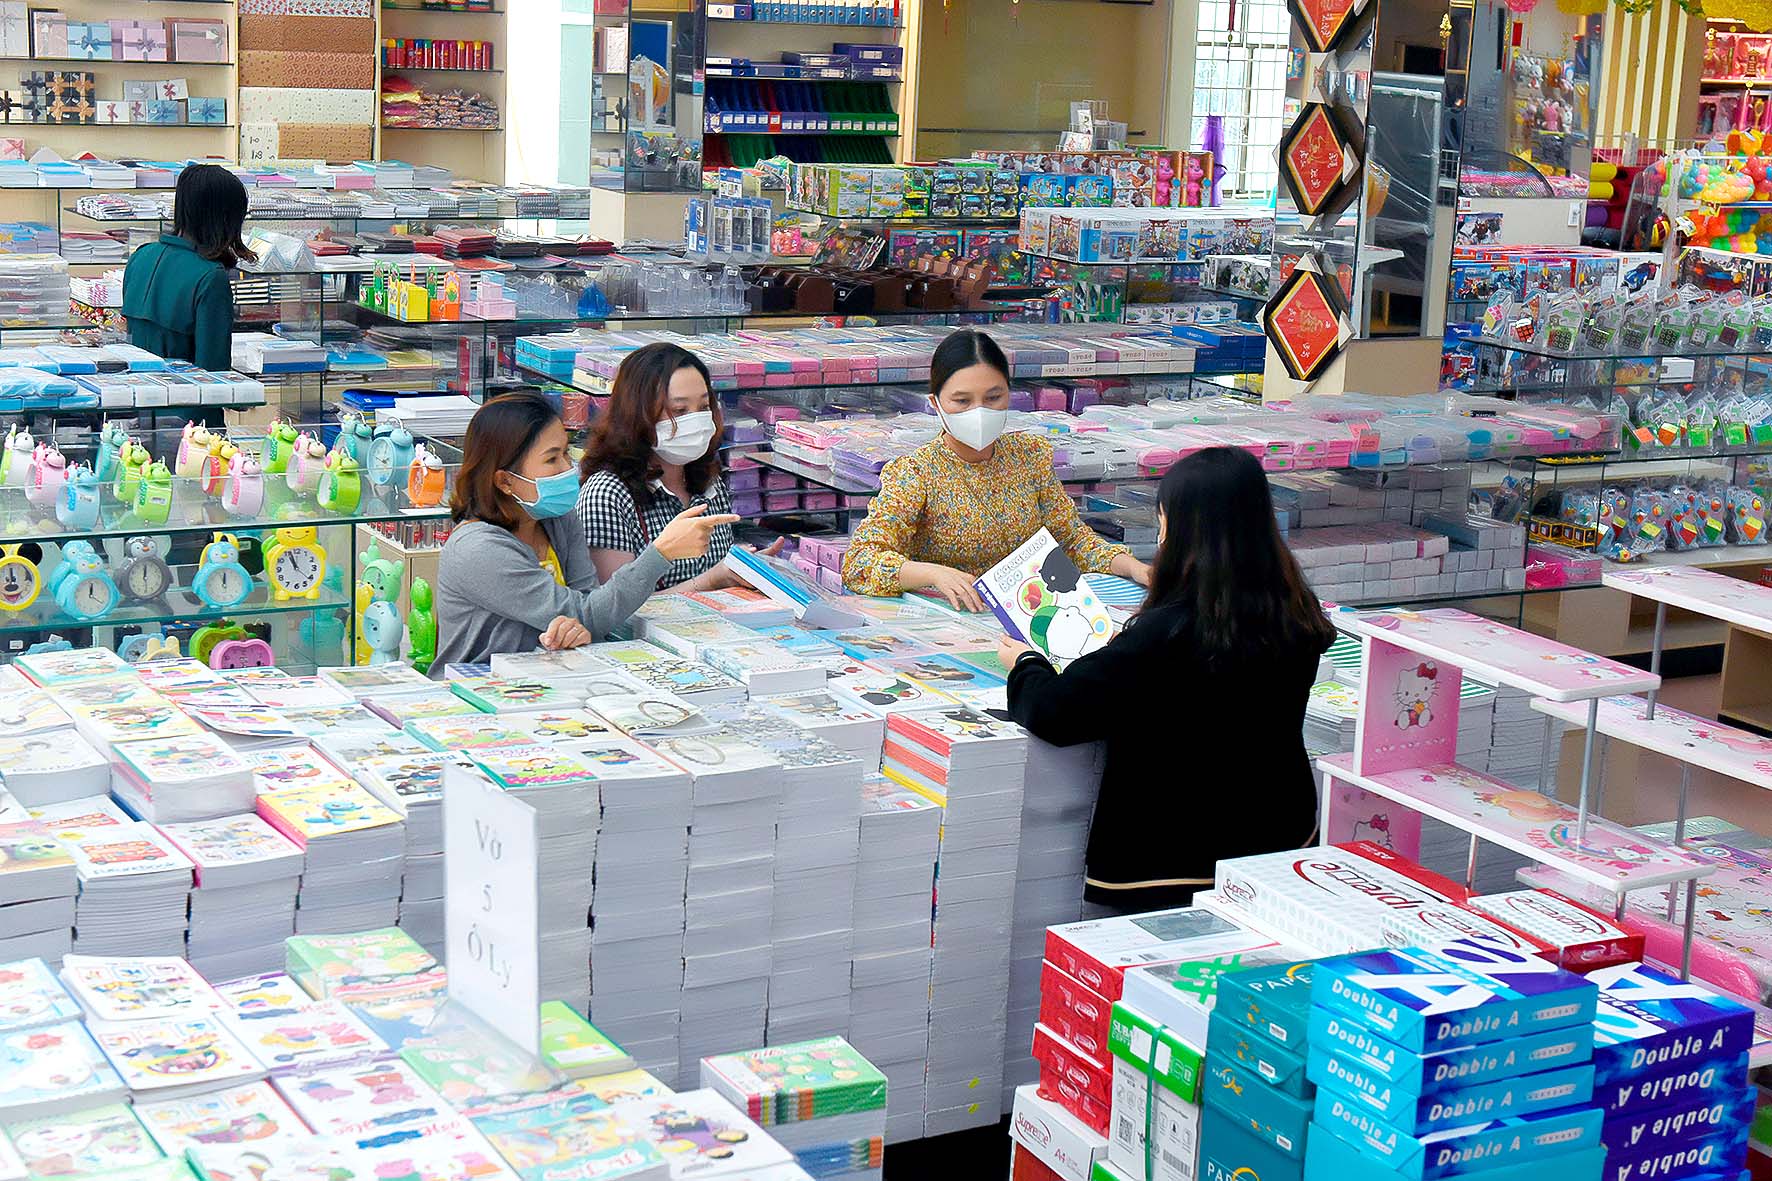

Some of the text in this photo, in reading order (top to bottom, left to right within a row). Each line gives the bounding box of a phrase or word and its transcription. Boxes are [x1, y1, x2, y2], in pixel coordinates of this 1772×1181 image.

[1249, 972, 1314, 993] PAPE
[1332, 979, 1382, 1014] Double
[1388, 1007, 1399, 1022] A
[1595, 992, 1662, 1022] Doubl
[1437, 1016, 1501, 1040] Double
[1507, 1010, 1519, 1027] A
[1327, 1021, 1395, 1065] Double A
[1630, 1029, 1724, 1069] Double A
[1327, 1059, 1377, 1094] Double
[1381, 1089, 1391, 1103] A
[1434, 1057, 1498, 1081] Double
[1504, 1050, 1515, 1066] A
[1640, 1068, 1715, 1100] Double
[1428, 1097, 1494, 1121] Double
[1501, 1091, 1512, 1106] A
[1652, 1104, 1724, 1136] Double
[1332, 1102, 1382, 1139] Double
[1386, 1133, 1397, 1148] A
[1437, 1143, 1502, 1166] Double
[1509, 1136, 1520, 1151] A
[1639, 1145, 1714, 1178] Double
